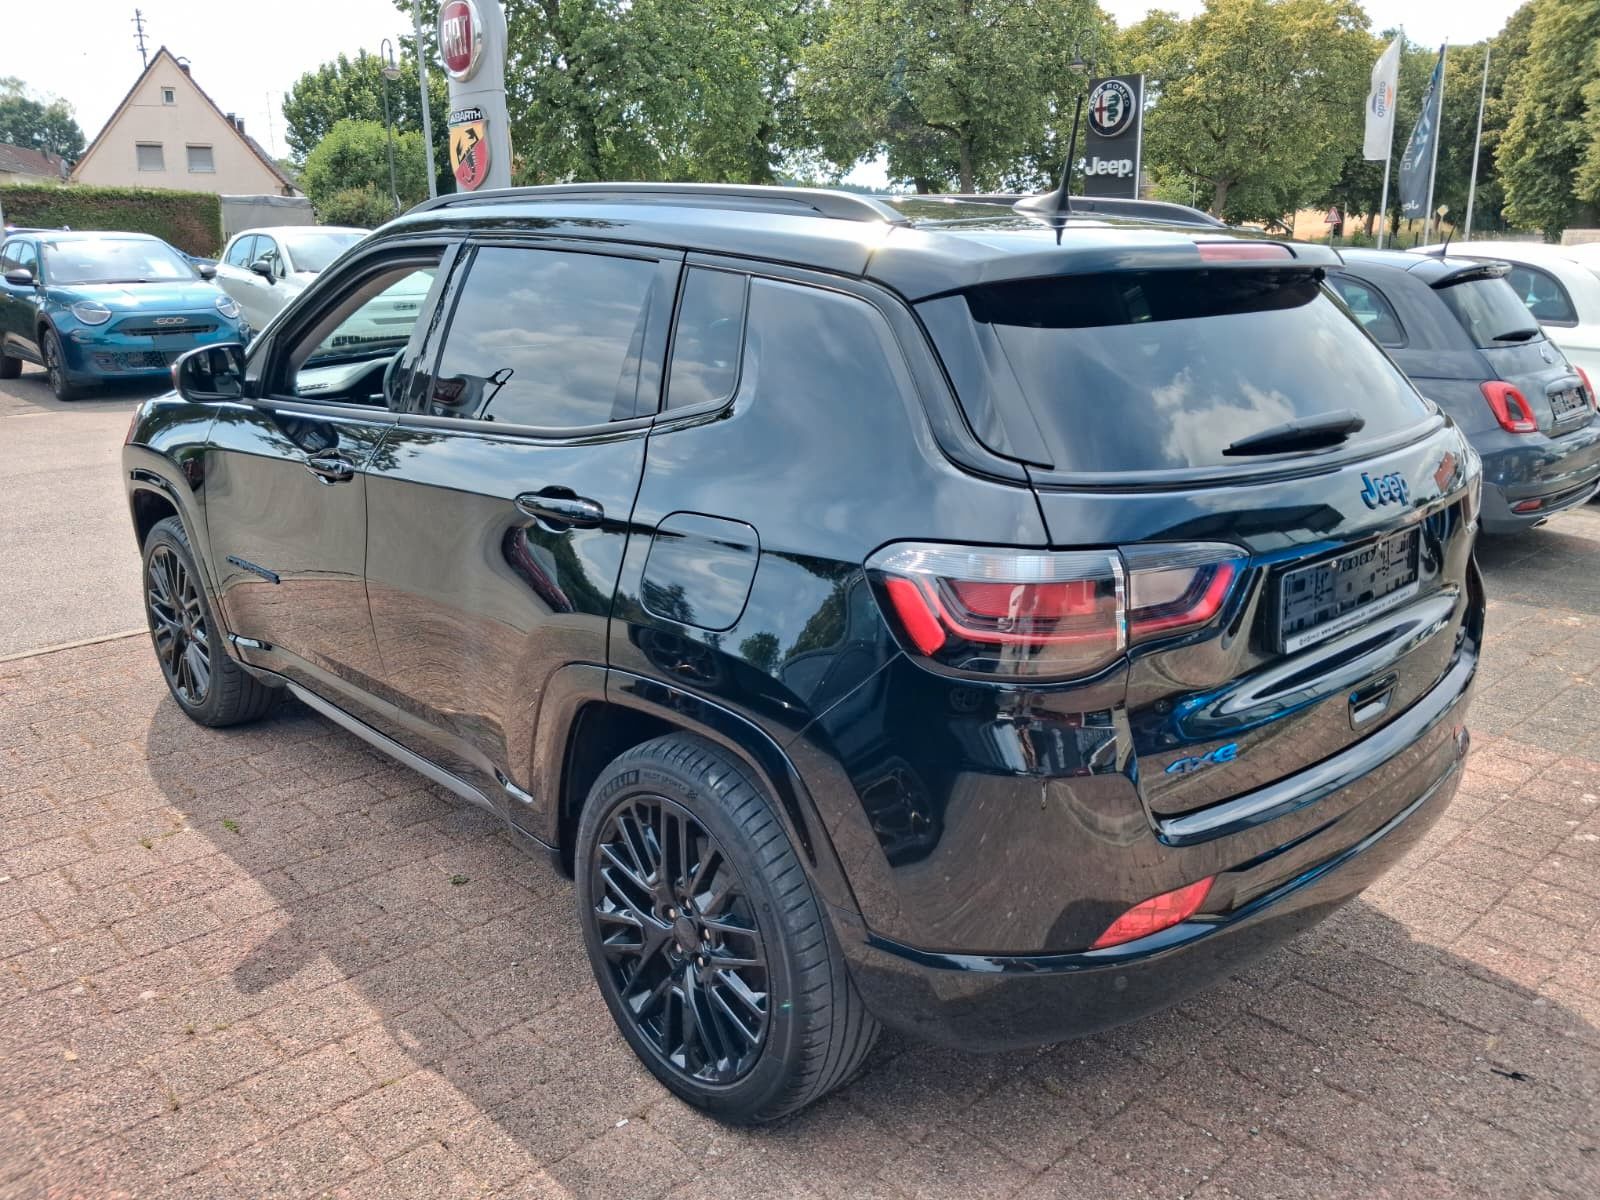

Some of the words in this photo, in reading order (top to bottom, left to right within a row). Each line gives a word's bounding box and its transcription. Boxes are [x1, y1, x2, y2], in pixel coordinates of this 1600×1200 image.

[443, 15, 468, 59] FIAT
[1106, 83, 1130, 107] ROMEO
[450, 109, 482, 124] ABARTH
[1085, 156, 1133, 177] Jeep
[1361, 472, 1408, 510] Jeep
